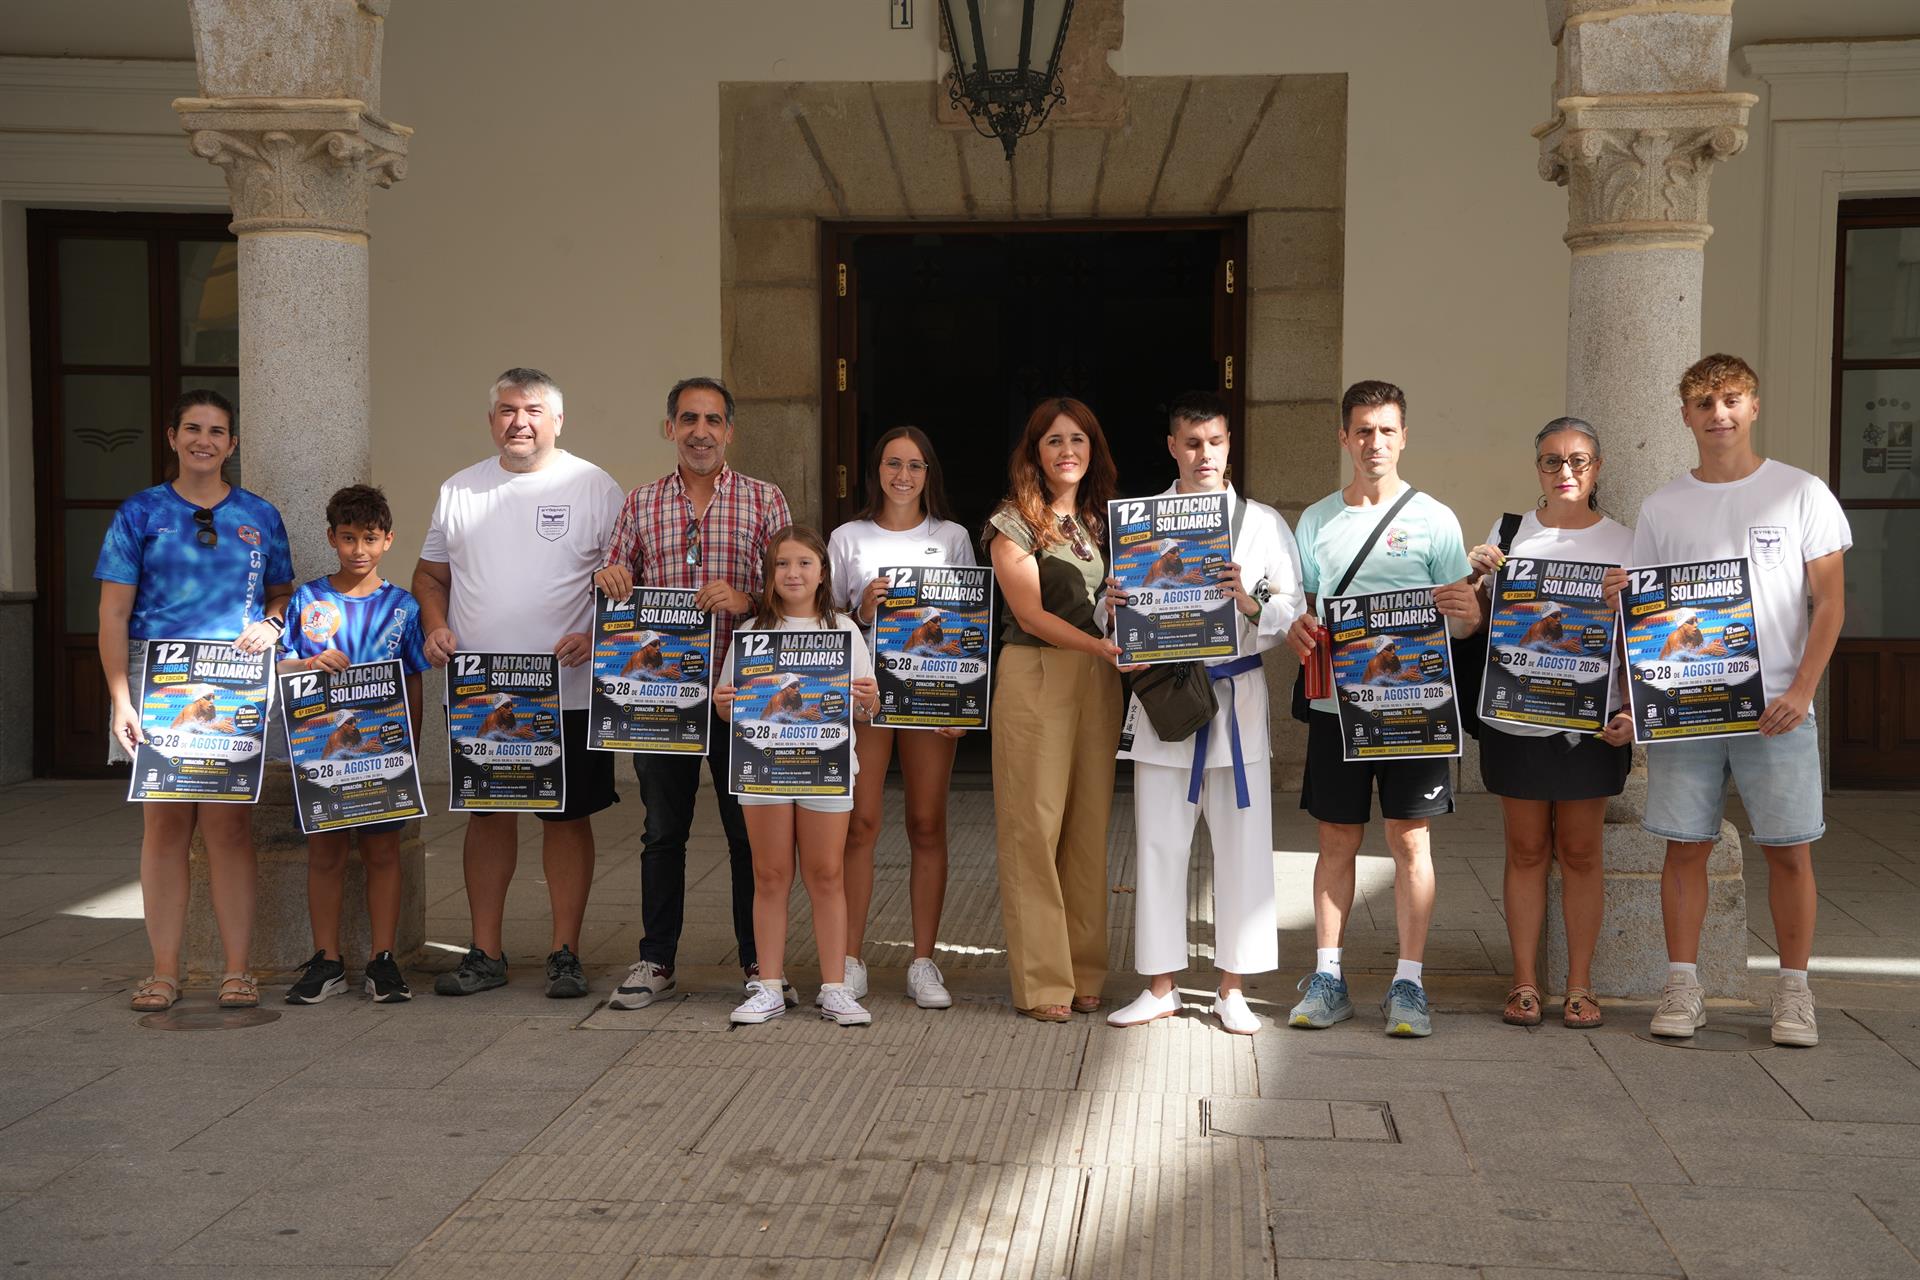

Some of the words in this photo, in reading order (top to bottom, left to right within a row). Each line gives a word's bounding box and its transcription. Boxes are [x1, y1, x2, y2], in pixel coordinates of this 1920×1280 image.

[901, 0, 909, 25] 1
[1117, 502, 1144, 525] 12
[1157, 497, 1220, 514] NATACION
[1127, 521, 1150, 532] HORAS
[1156, 513, 1222, 531] SOLIDARIAS
[250, 551, 261, 568] CS
[886, 568, 912, 588] 12
[923, 569, 984, 584] NATACION
[1507, 559, 1534, 580] 12
[1671, 561, 1740, 582] NATACION
[1511, 581, 1536, 589] HORAS
[1542, 579, 1602, 598] SOLIDARIA
[1628, 570, 1657, 595] 12
[1671, 579, 1743, 600] SOLIDARIAS
[642, 592, 697, 608] NATACIO
[893, 588, 916, 597] HORAS
[921, 585, 983, 601] SOLIDARIAS
[1140, 592, 1152, 605] 28
[1163, 589, 1200, 603] AGOSTO
[1369, 589, 1435, 610] NATACION
[1638, 590, 1664, 602] HORAS
[611, 611, 634, 620] HORAS
[640, 609, 704, 624] SOLIDARIAS
[1329, 598, 1356, 622] 12
[1370, 605, 1437, 627] SOLIDARIAS
[1340, 618, 1364, 630] HORAS
[742, 634, 769, 656] 12
[781, 634, 844, 648] NATACION
[157, 643, 185, 663] 12
[750, 655, 773, 664] HORAS
[779, 651, 844, 665] SOLIDARIAS
[162, 663, 188, 672] HORAS
[194, 661, 262, 679] SOLIDARIAS
[455, 655, 480, 675] 12
[492, 656, 551, 670] NATACION
[898, 657, 911, 670] 28
[920, 659, 957, 672] AGOSTO
[959, 662, 978, 673] 2026
[1512, 652, 1527, 665] 28
[1536, 655, 1576, 671] AGOSTO
[1578, 661, 1599, 672] 2026
[1657, 665, 1671, 679] 28
[1682, 662, 1723, 677] AGOSTO
[1727, 660, 1749, 673] 2026
[330, 664, 393, 686] NATACION
[463, 674, 485, 684] HORAS
[491, 672, 552, 686] SOLIDARIAS
[289, 674, 316, 698] 12
[330, 680, 396, 703] SOLIDARIAS
[616, 682, 629, 694] 28
[639, 684, 677, 696] AGOSTO
[679, 686, 699, 697] 2026
[1360, 689, 1374, 701] 28
[1384, 687, 1420, 700] AGOSTO
[1423, 687, 1443, 698] 2026
[300, 693, 324, 706] HORAS
[756, 725, 769, 738] 28
[779, 726, 817, 738] AGOSTO
[820, 728, 839, 738] 2026
[164, 734, 179, 747] 28
[189, 736, 229, 750] AGOSTO
[231, 740, 252, 751] 2026
[474, 743, 486, 754] 28
[496, 744, 531, 755] AGOSTO
[534, 746, 552, 755] 2026
[320, 764, 334, 777] 28
[344, 758, 381, 774] AGOSTO
[384, 755, 404, 768] 2026
